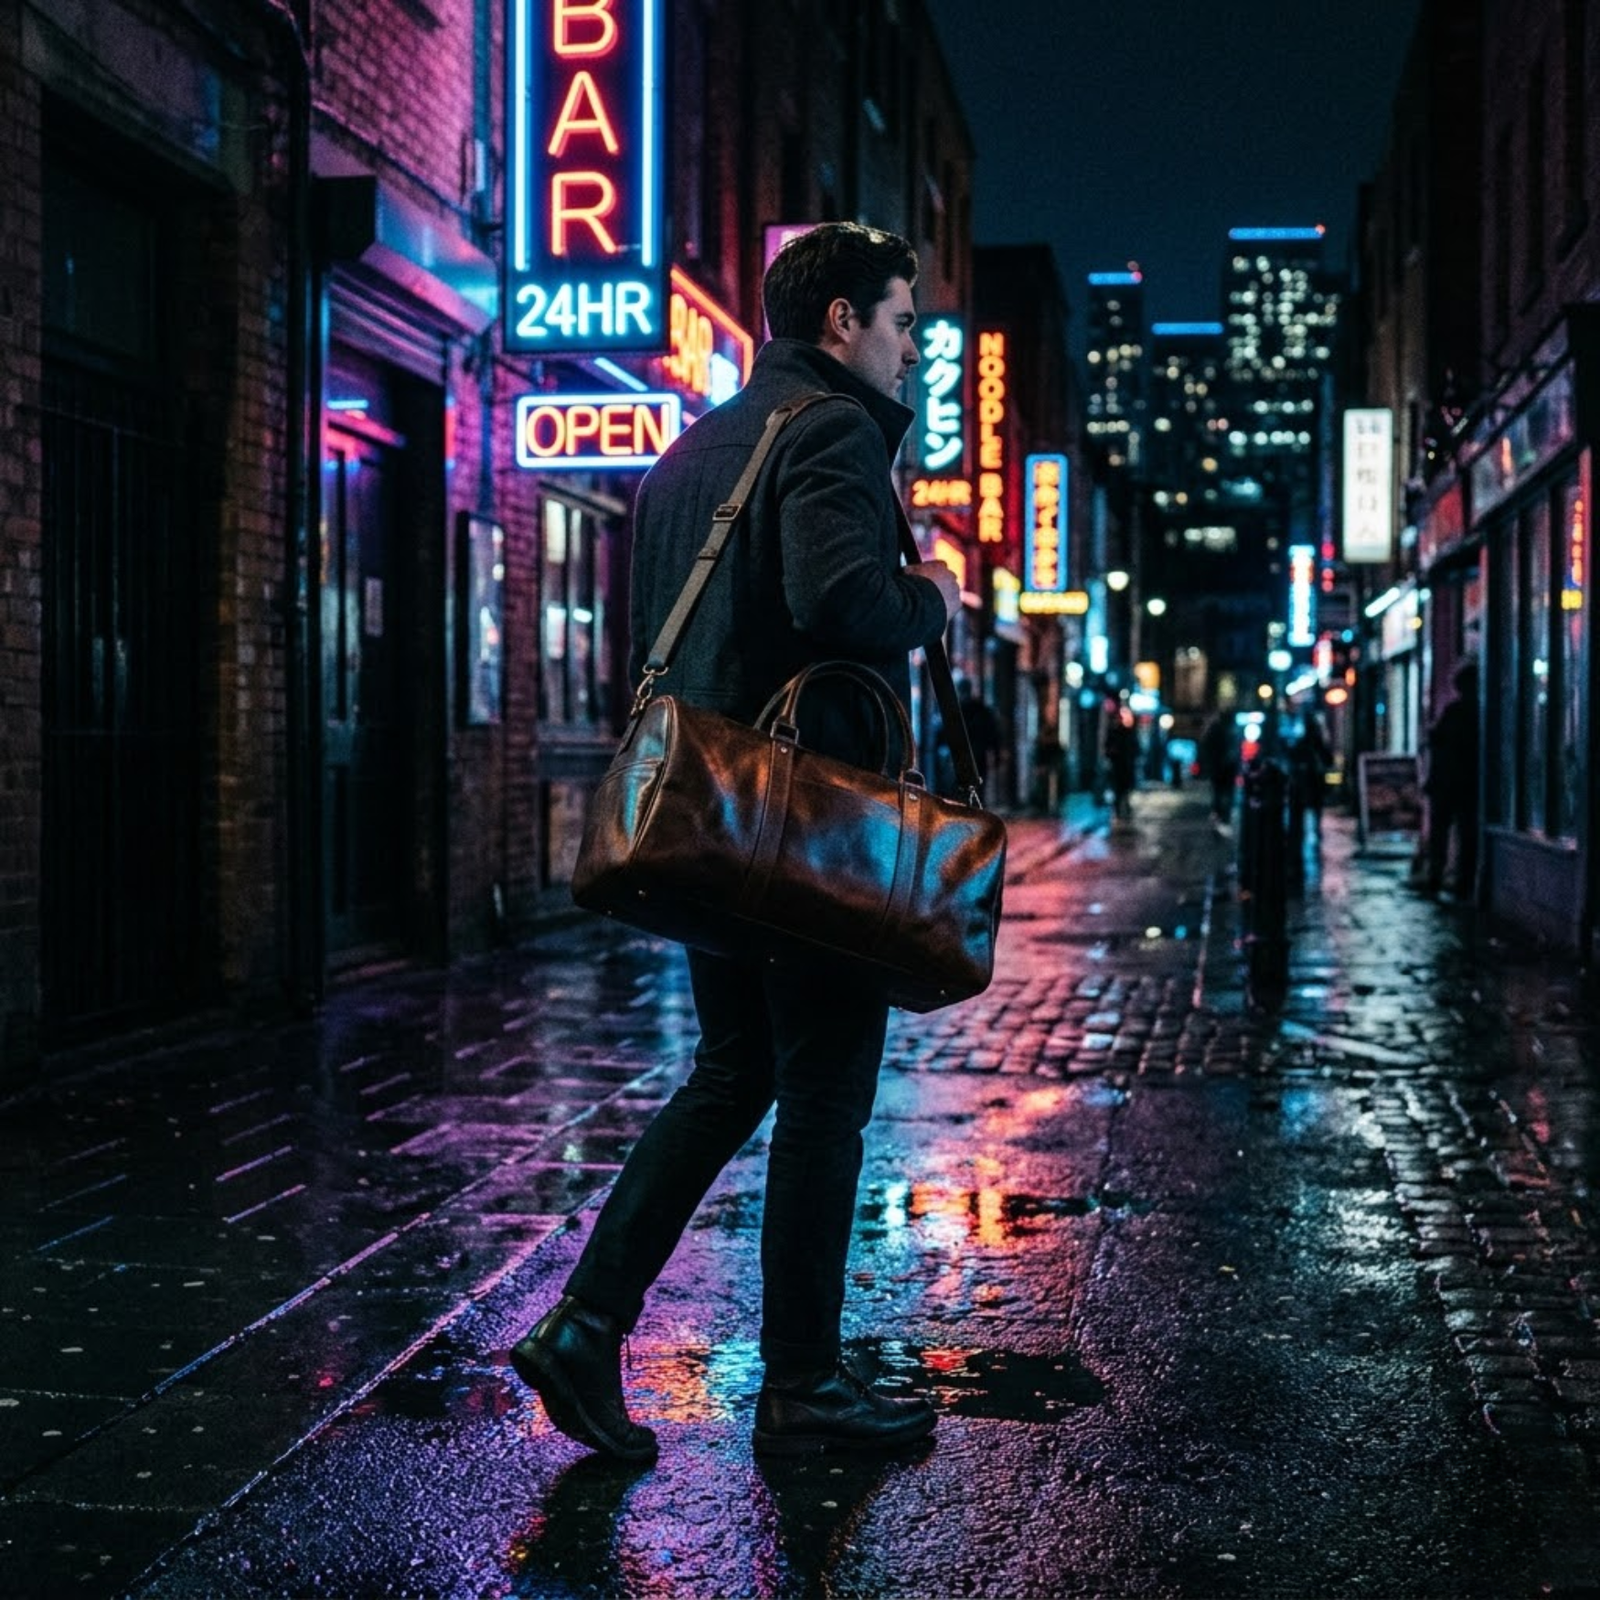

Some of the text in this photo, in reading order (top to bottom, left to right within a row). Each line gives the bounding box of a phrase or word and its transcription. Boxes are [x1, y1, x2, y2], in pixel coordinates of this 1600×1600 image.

[548, 0, 618, 256] BAR
[516, 281, 653, 337] 24HR
[526, 404, 671, 457] OPEN
[978, 332, 1005, 543] NOODLE BAR
